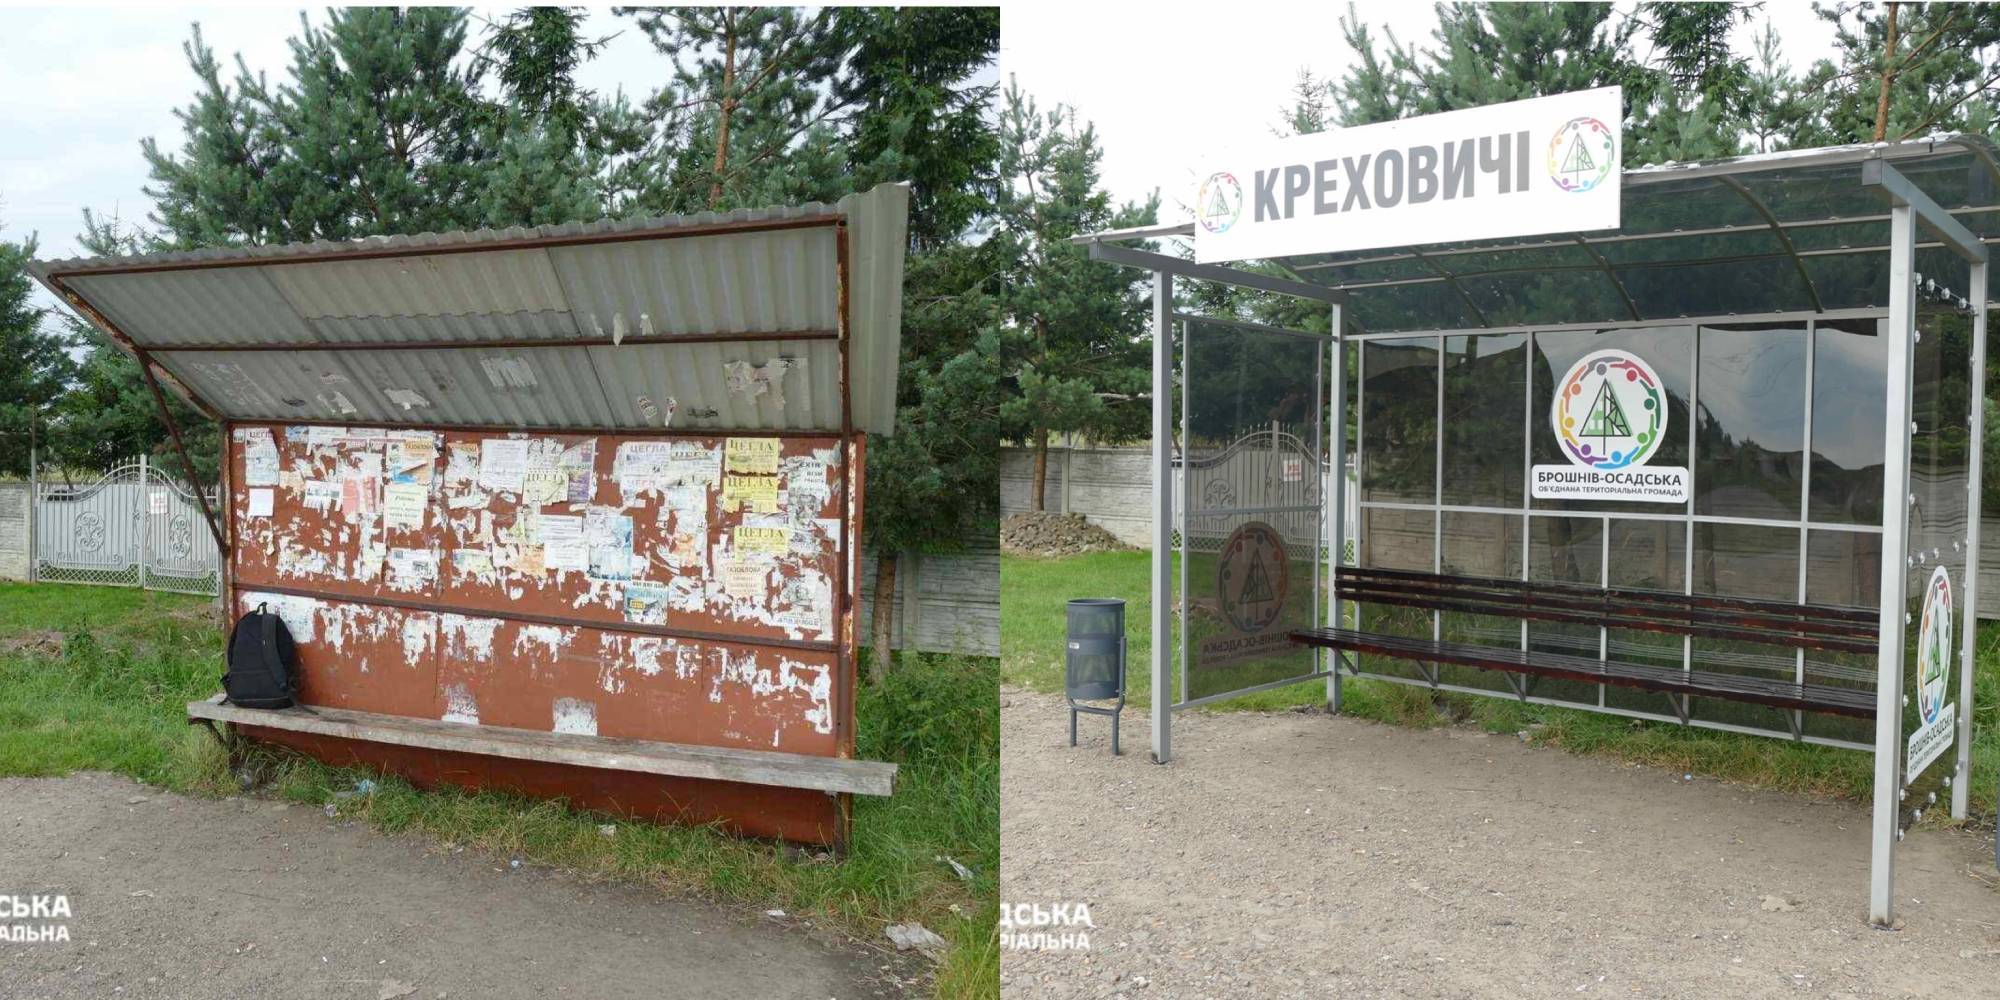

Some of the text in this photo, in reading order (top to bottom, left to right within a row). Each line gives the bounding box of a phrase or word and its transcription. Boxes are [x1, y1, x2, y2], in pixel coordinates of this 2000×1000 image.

[1254, 130, 1530, 223] КРЕХОВИЧІ
[630, 445, 666, 453] ЦЕГЛА
[729, 439, 773, 451] ЦЕГЛА
[728, 477, 773, 487] ЦЕГЛА
[1538, 471, 1682, 487] БРОШНІВ-ОСАДСЬКА
[1582, 486, 1643, 495] ТЕРИТОРІАЛЬНА
[1643, 488, 1683, 496] ГРОМАДА
[739, 527, 785, 538] ЦЕГЛА
